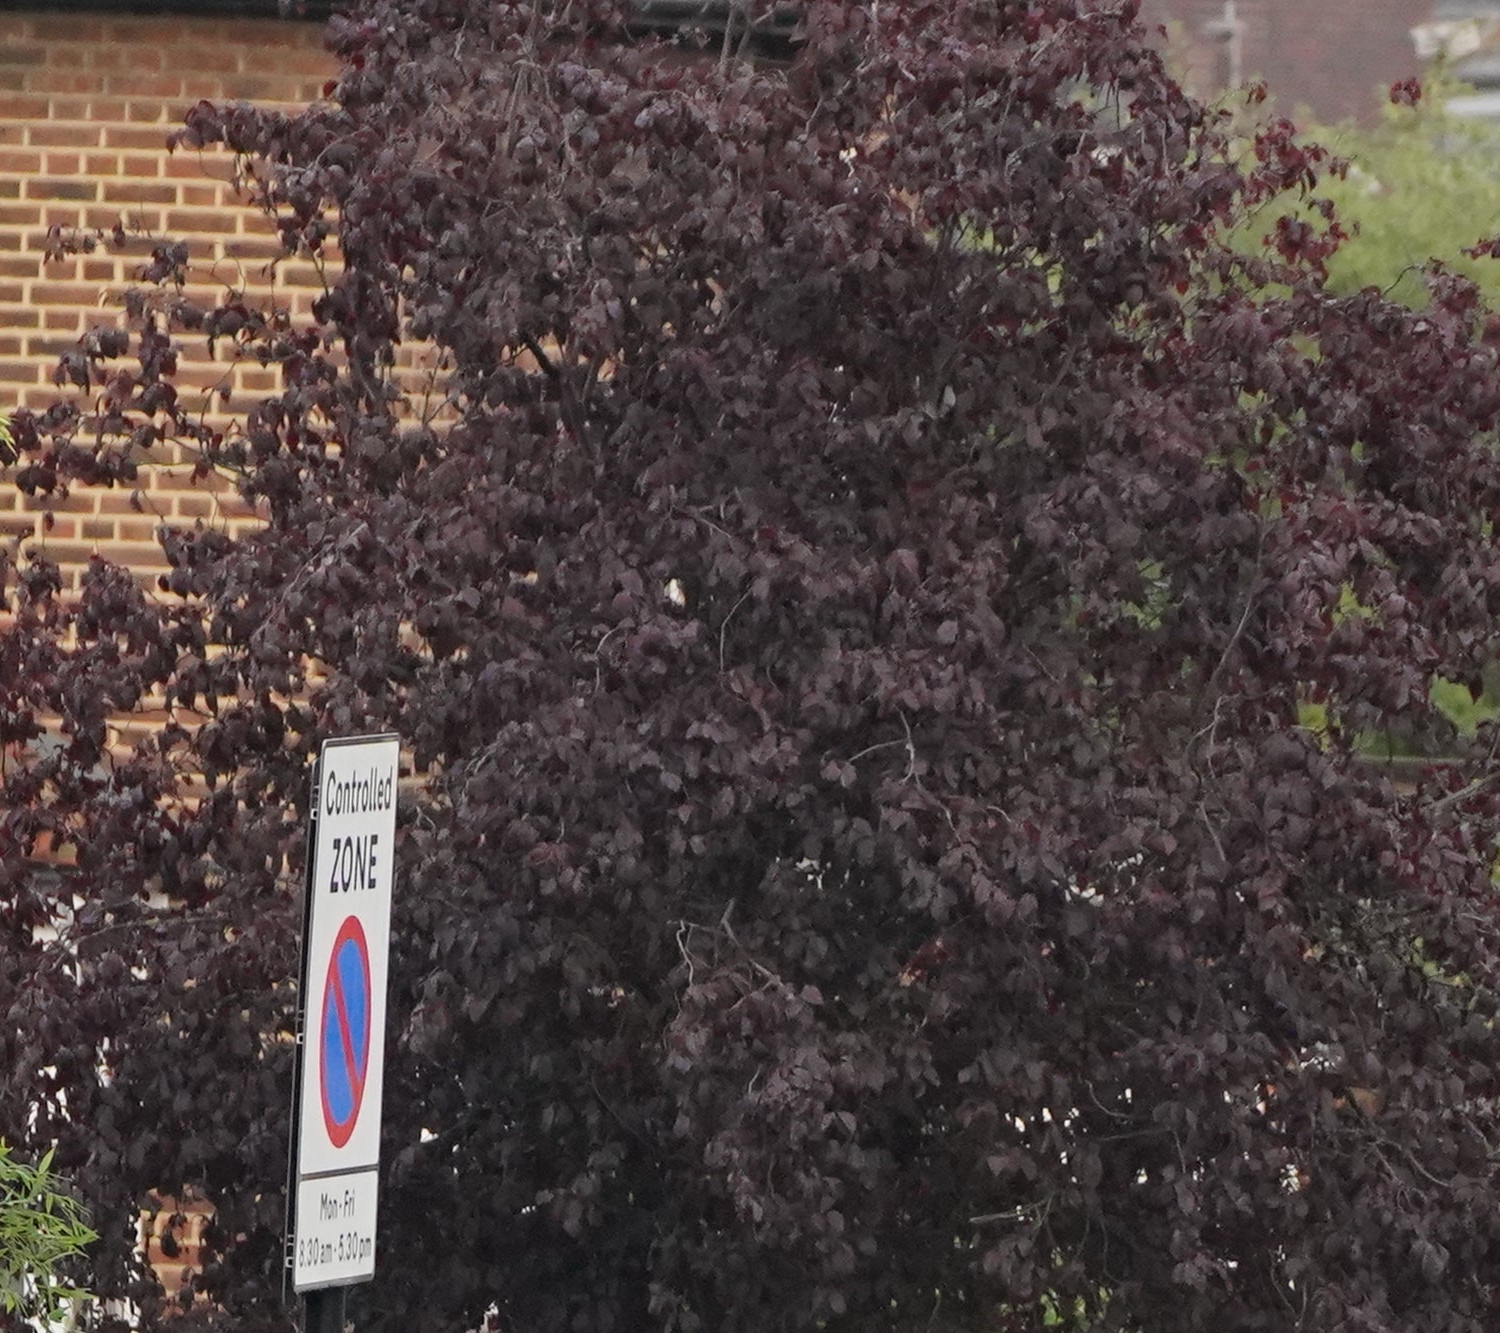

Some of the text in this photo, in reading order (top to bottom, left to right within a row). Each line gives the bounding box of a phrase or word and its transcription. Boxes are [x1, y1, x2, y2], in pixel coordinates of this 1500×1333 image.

[326, 766, 393, 816] Controlled
[330, 834, 378, 893] ZONE
[320, 1192, 337, 1220] Mon
[343, 1189, 355, 1218] Fri
